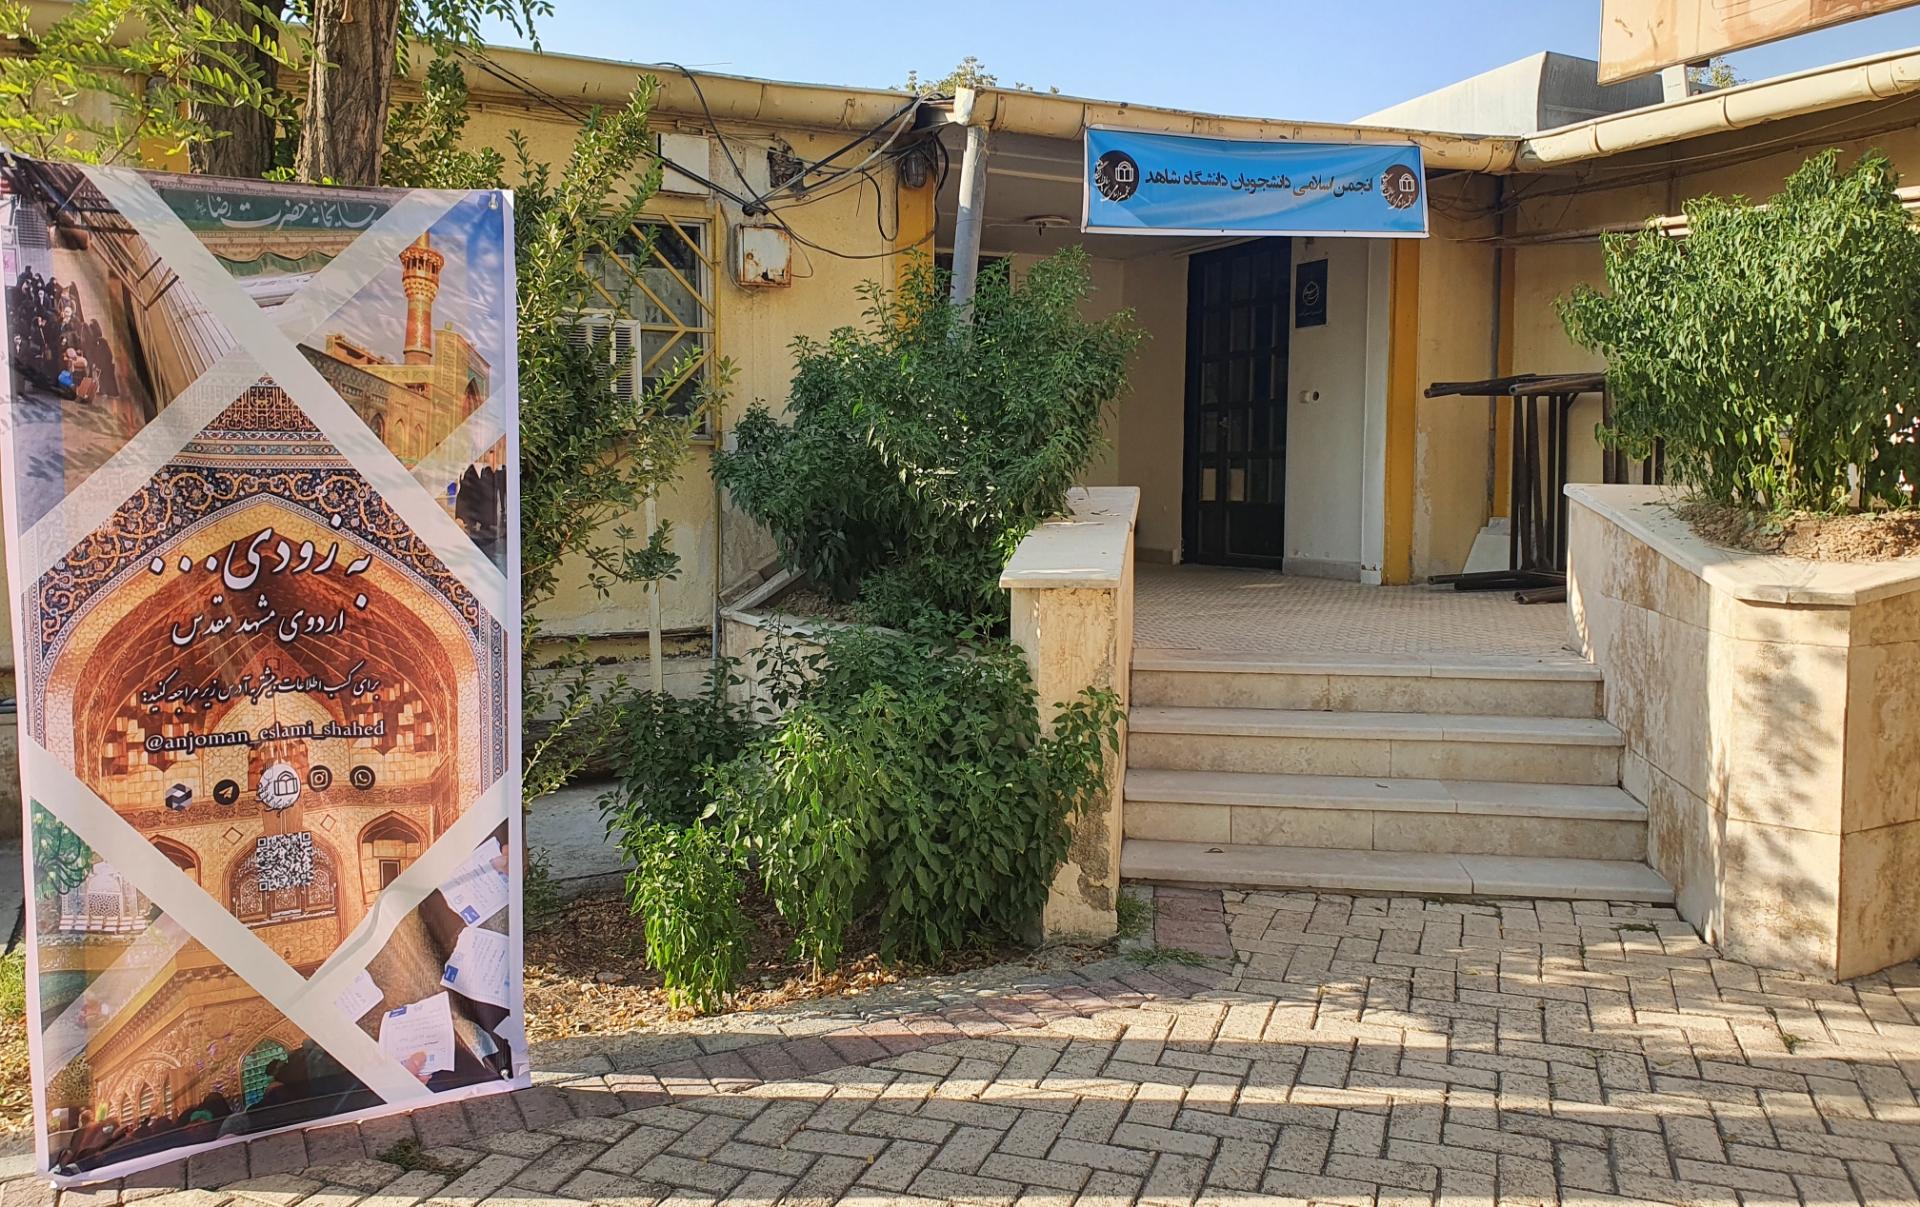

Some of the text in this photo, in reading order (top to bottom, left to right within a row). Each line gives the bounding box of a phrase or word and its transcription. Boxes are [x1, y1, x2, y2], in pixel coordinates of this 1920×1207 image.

[1145, 168, 1181, 185] شاهد
[1183, 170, 1228, 187] دانشگاه
[1230, 173, 1292, 194] دانشجویان
[1293, 174, 1335, 196] اسلامی
[1333, 177, 1374, 197] انجمن
[220, 199, 308, 231] حضرت
[171, 593, 345, 646] اردوی مشهد مقدس
[218, 675, 252, 701] آدرس
[253, 665, 277, 698] بیشتر
[278, 676, 323, 692] اطلاعات
[323, 659, 366, 699] کسب
[353, 678, 380, 700] برای
[167, 686, 200, 714] مراجعه
[200, 678, 218, 707] زیر
[145, 720, 385, 755] @anjoman_eslami_shahed
